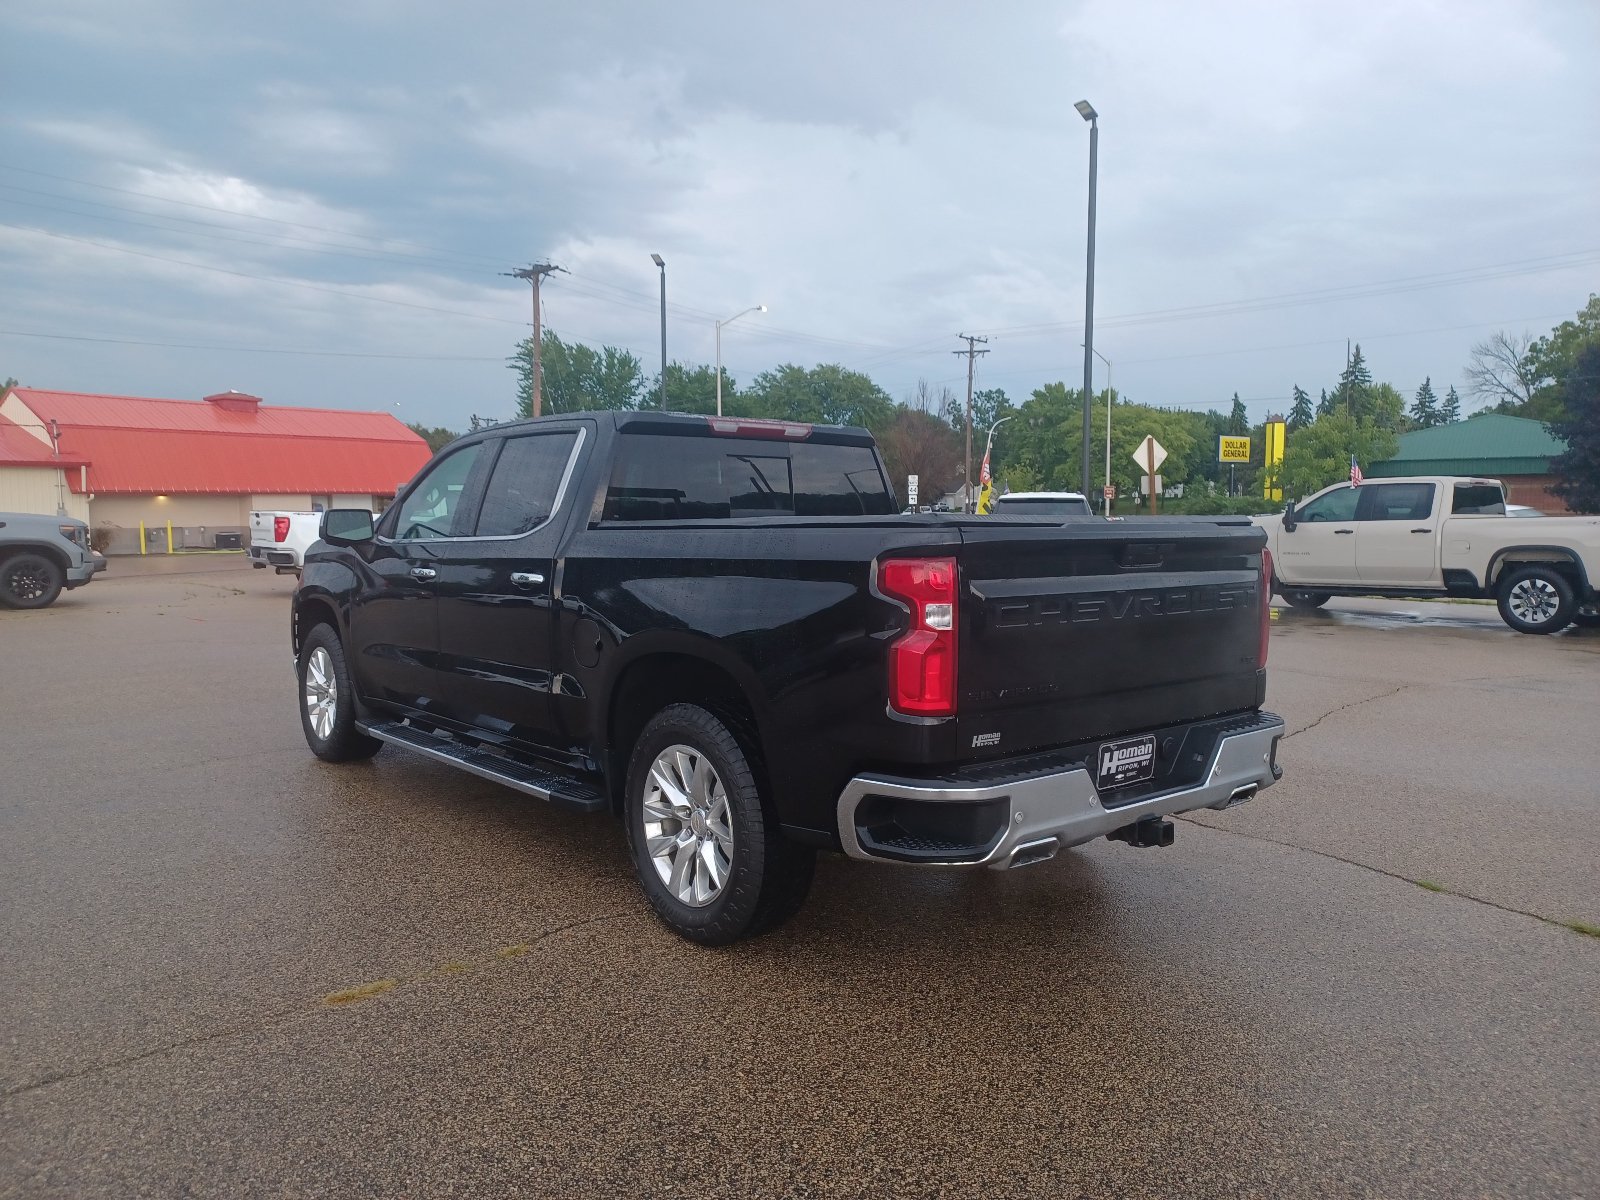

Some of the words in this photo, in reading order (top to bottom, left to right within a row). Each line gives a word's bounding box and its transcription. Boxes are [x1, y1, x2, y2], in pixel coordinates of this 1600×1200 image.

[1223, 450, 1248, 458] GENERAL
[1225, 441, 1247, 449] DOLLAR
[996, 586, 1256, 628] CHEVROLET
[1101, 744, 1152, 776] Homan
